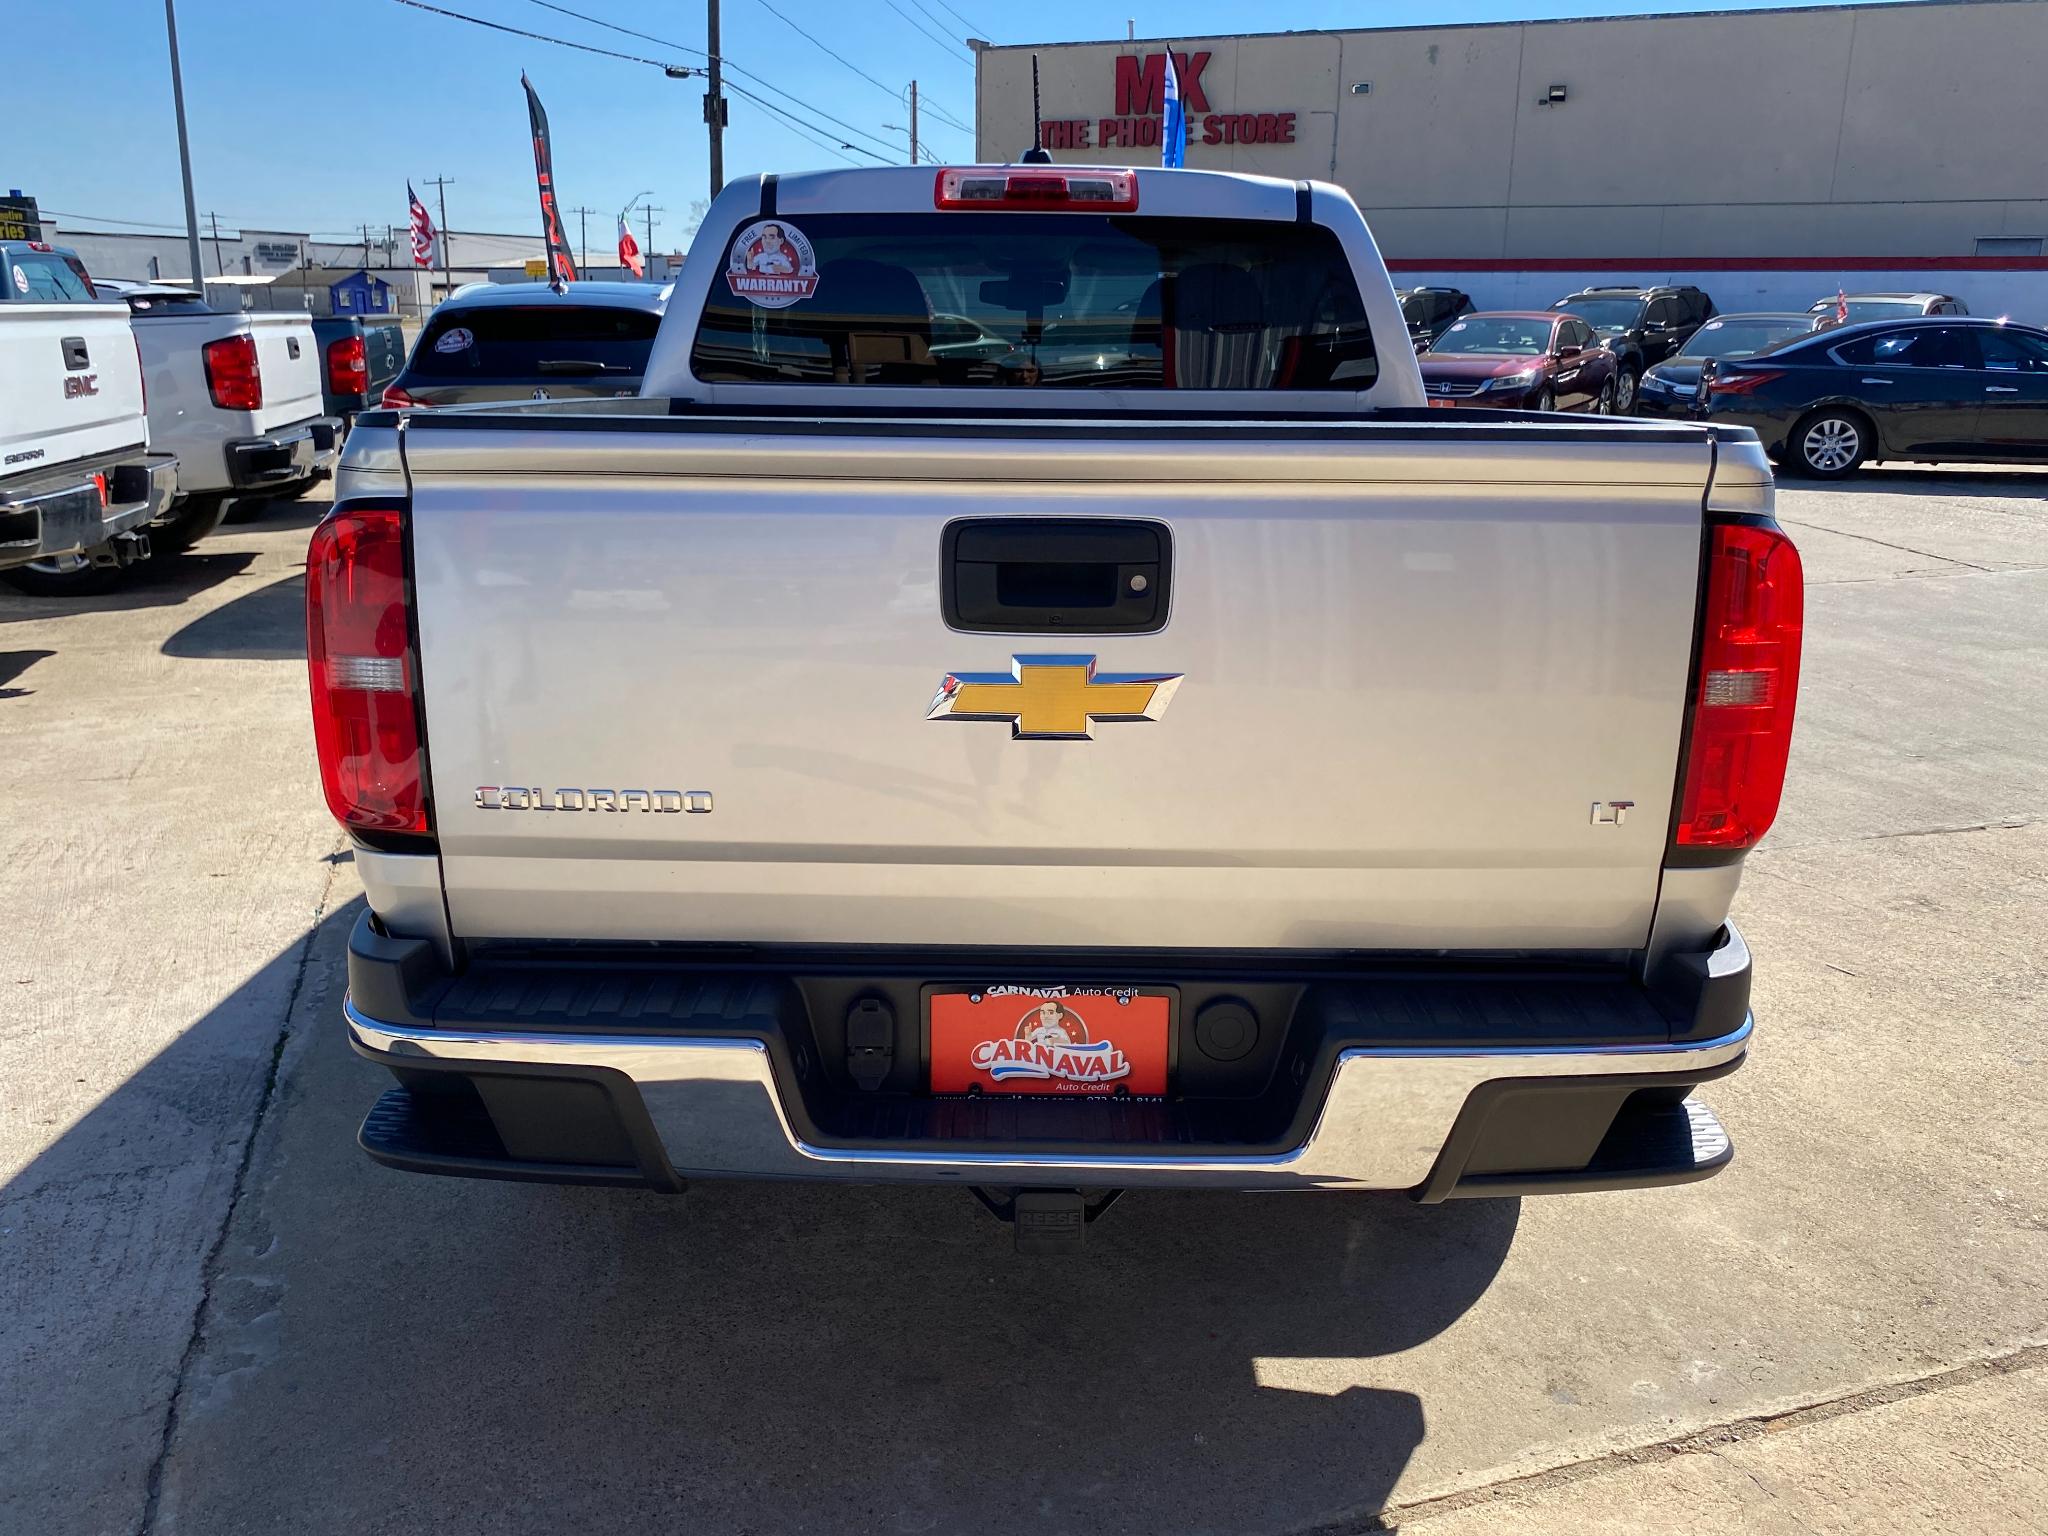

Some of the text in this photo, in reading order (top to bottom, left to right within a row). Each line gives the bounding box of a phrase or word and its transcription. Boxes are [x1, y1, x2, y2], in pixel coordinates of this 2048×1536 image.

[1115, 52, 1211, 115] MK
[1040, 120, 1089, 149] THE
[1203, 113, 1295, 145] STORE
[741, 229, 809, 256] FREE LIMITED
[736, 278, 808, 293] WARRANTY
[64, 374, 99, 400] GMC
[4, 448, 45, 465] SIERRA
[474, 786, 713, 813] COLORADO
[1589, 801, 1635, 825] LT
[986, 985, 1139, 998] CARNAVAL Auto Credit
[971, 1039, 1129, 1079] CARNAVAL
[1055, 1083, 1110, 1091] Auto Credit
